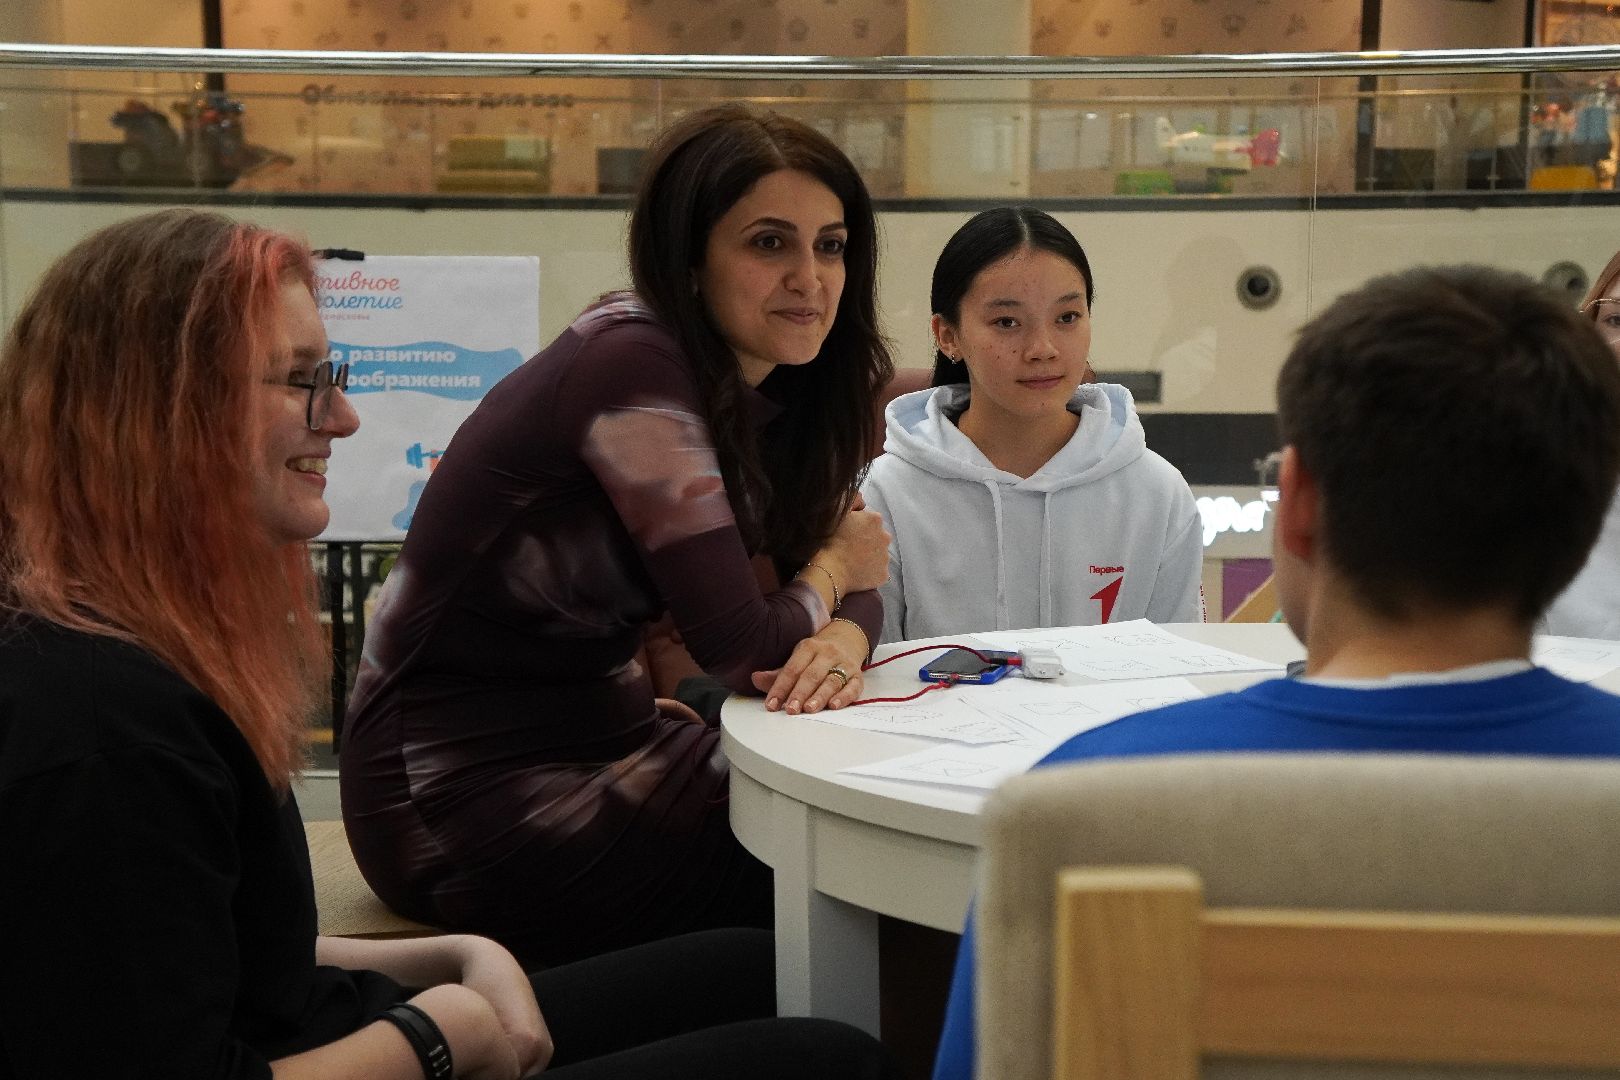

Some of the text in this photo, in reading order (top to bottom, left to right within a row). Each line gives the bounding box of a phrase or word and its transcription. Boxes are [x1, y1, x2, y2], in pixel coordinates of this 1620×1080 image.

[319, 294, 404, 309] олетие
[348, 349, 457, 366] развитию
[346, 370, 481, 392] оображения
[1089, 565, 1125, 576] Первые
